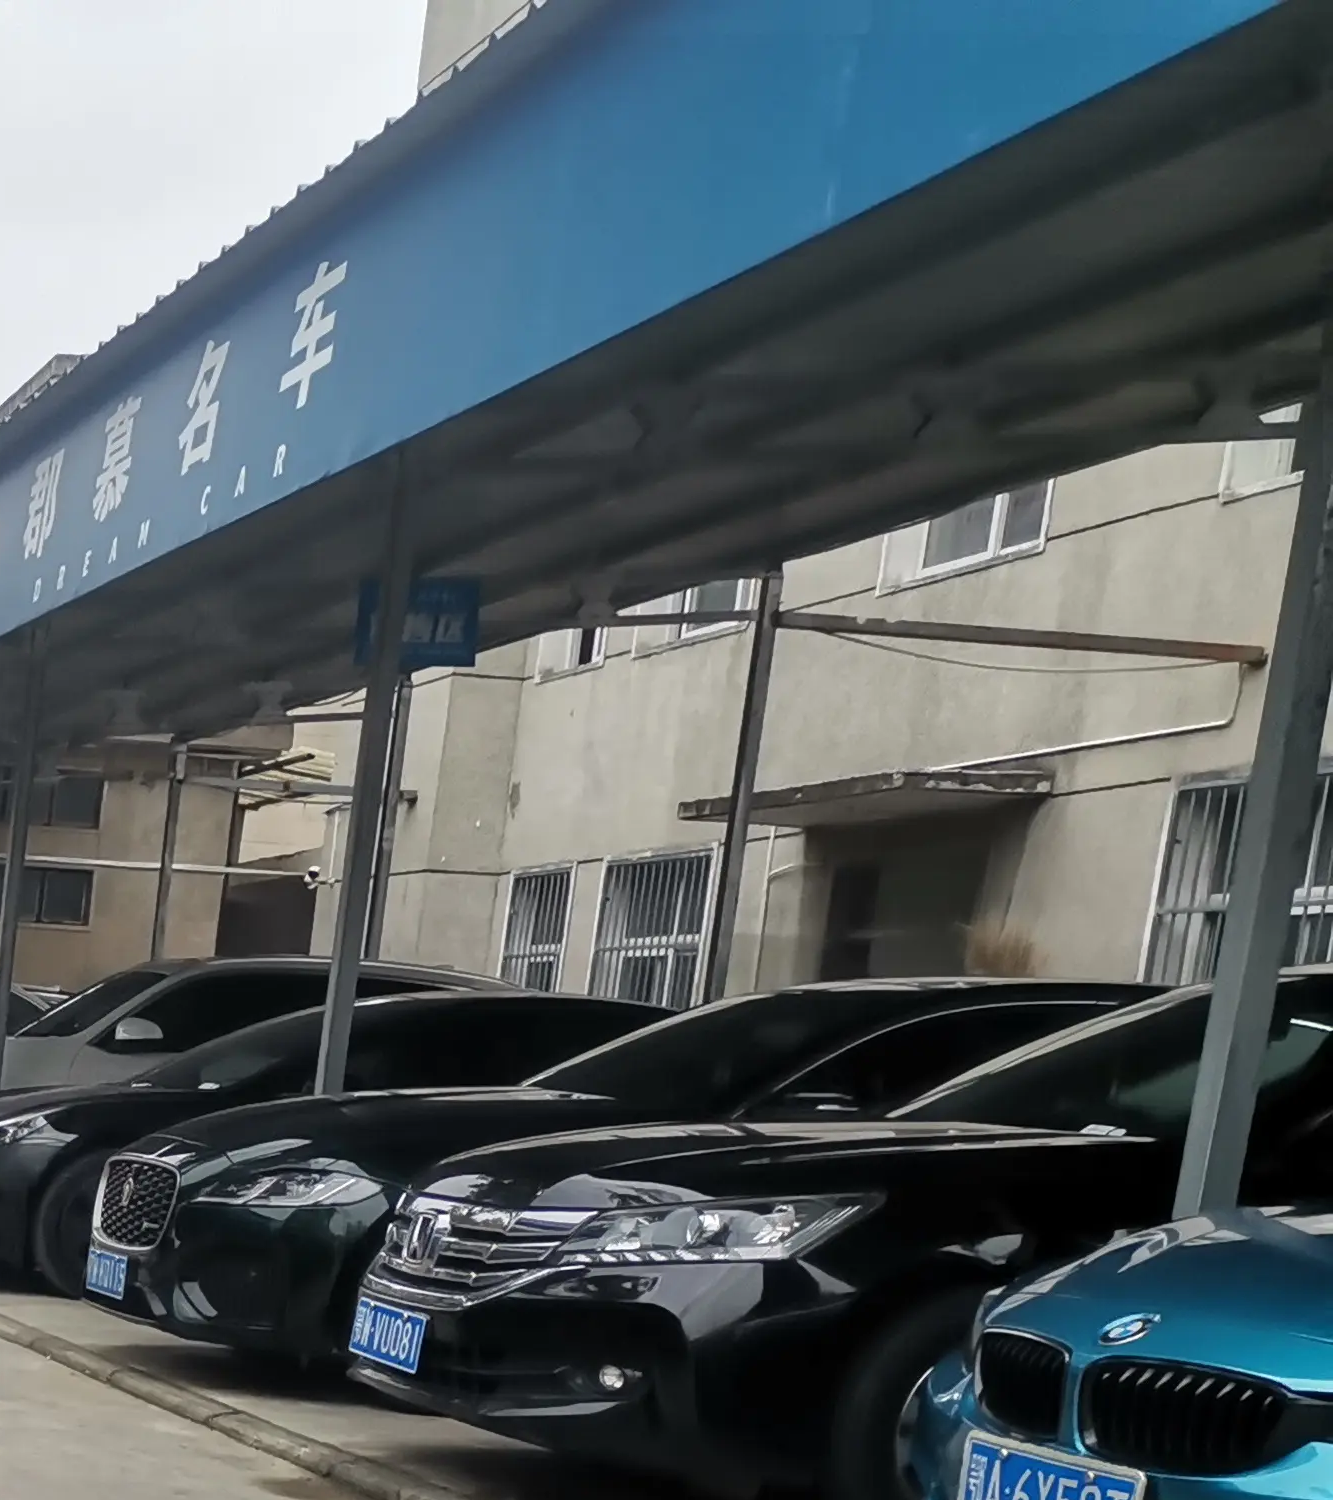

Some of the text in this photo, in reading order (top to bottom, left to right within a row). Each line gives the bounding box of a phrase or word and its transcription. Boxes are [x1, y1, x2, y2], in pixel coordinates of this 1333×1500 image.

[23, 261, 348, 560] 郡慕名车
[32, 443, 287, 603] DREAM CAR
